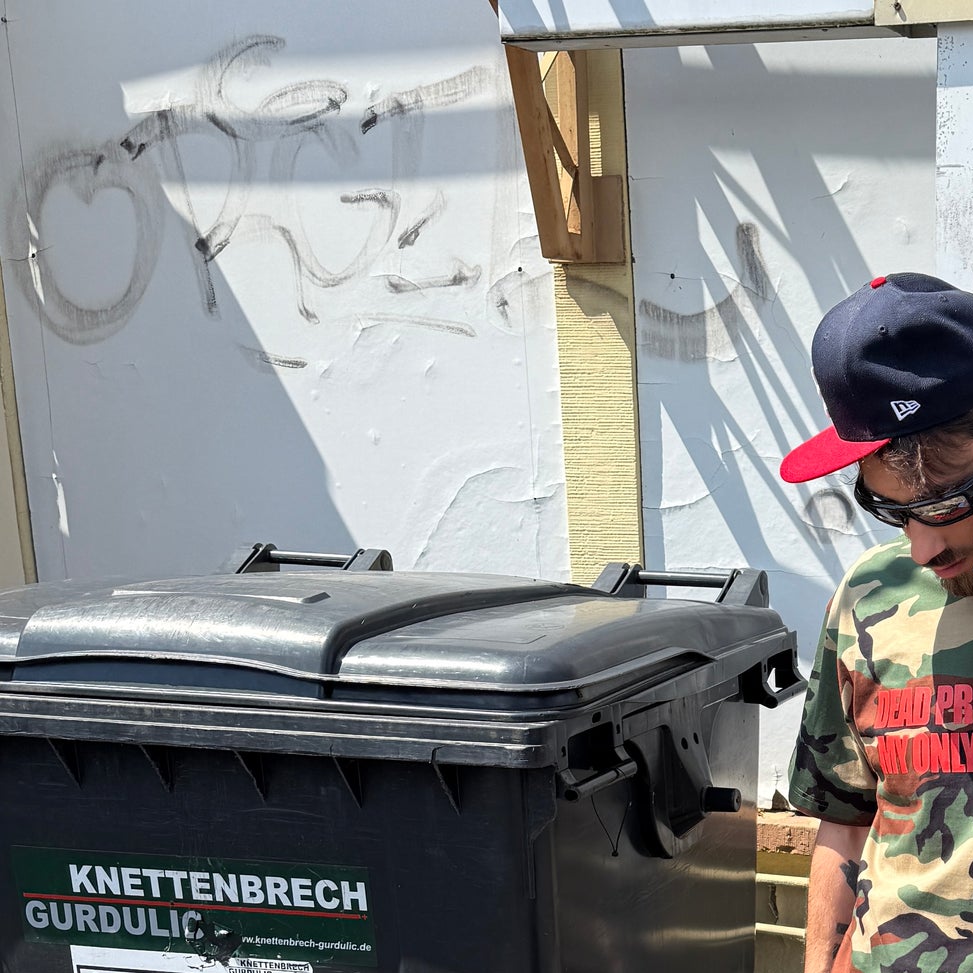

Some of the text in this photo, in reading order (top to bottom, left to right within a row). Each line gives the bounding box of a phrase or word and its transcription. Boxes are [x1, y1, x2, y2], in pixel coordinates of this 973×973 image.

[874, 687, 932, 728] DEAD
[877, 735, 909, 774] MY
[69, 864, 368, 911] KNETTENBRECH
[25, 900, 205, 940] GURDULIC
[240, 959, 310, 971] KNETTENBRECH
